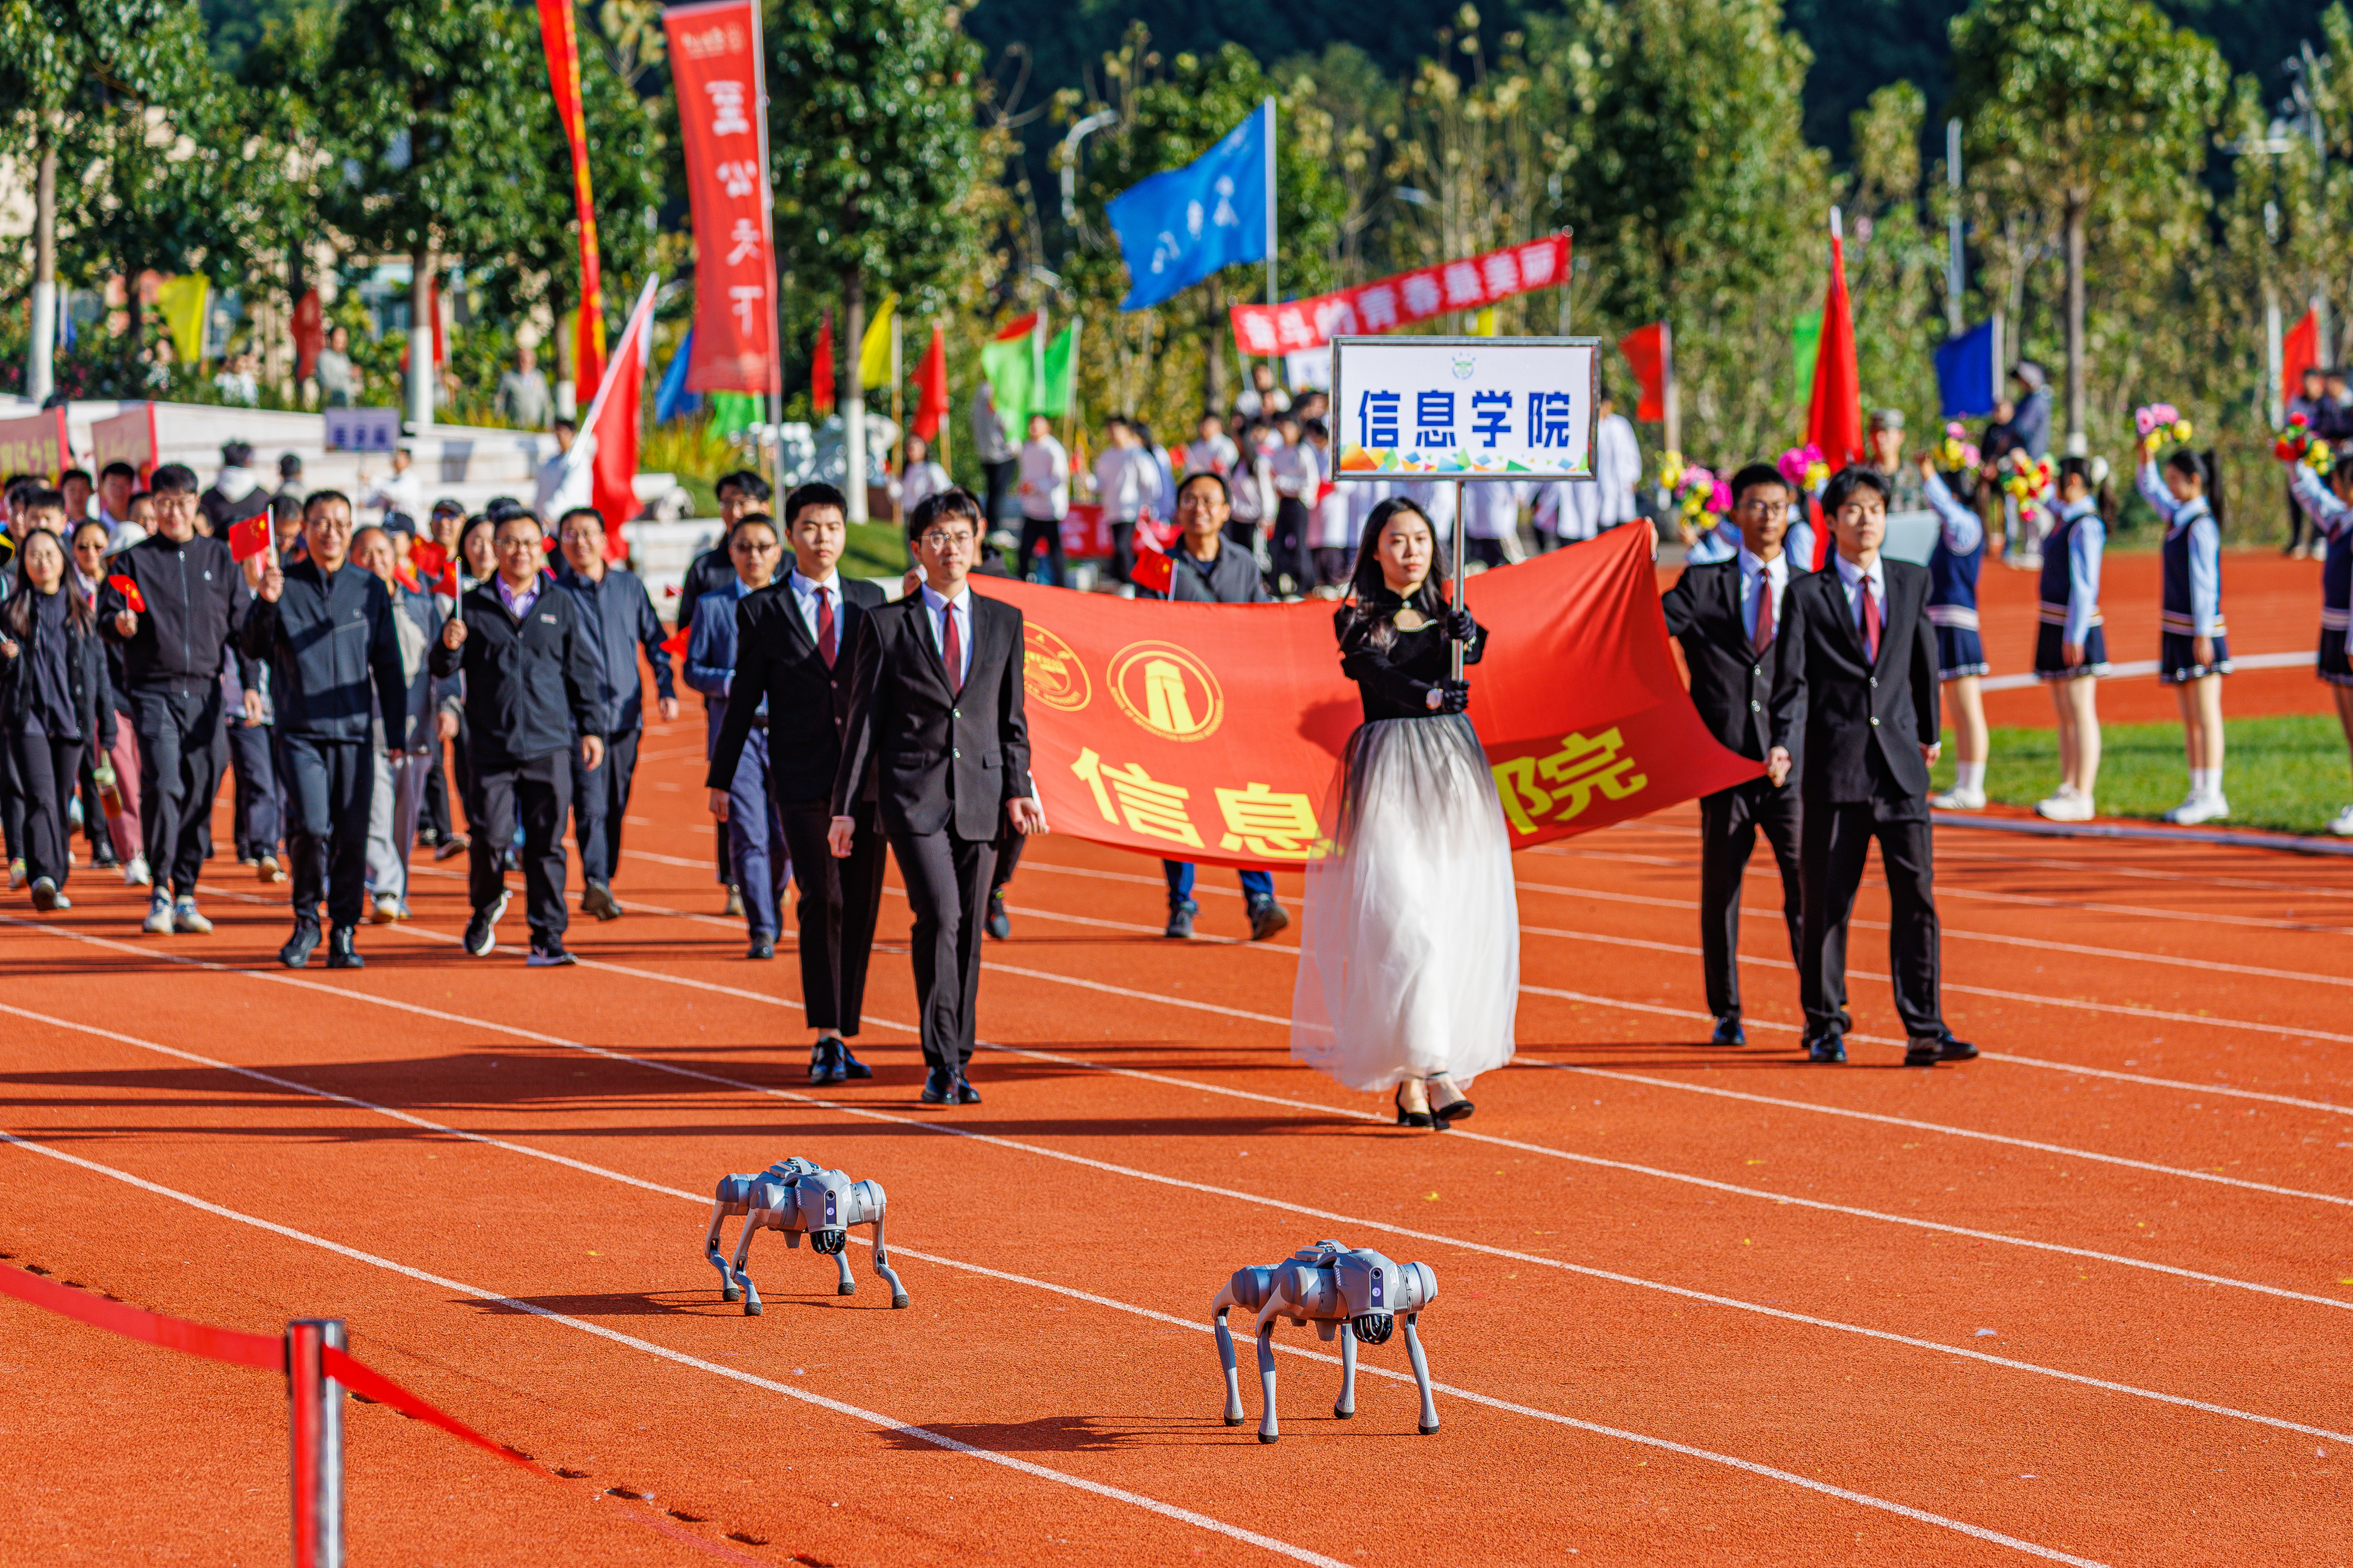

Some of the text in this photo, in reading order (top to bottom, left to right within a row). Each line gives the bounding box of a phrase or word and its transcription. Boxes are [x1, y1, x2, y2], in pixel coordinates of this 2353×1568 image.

[1358, 389, 1571, 448] 信息学院
[1070, 726, 1648, 859] 信息院
